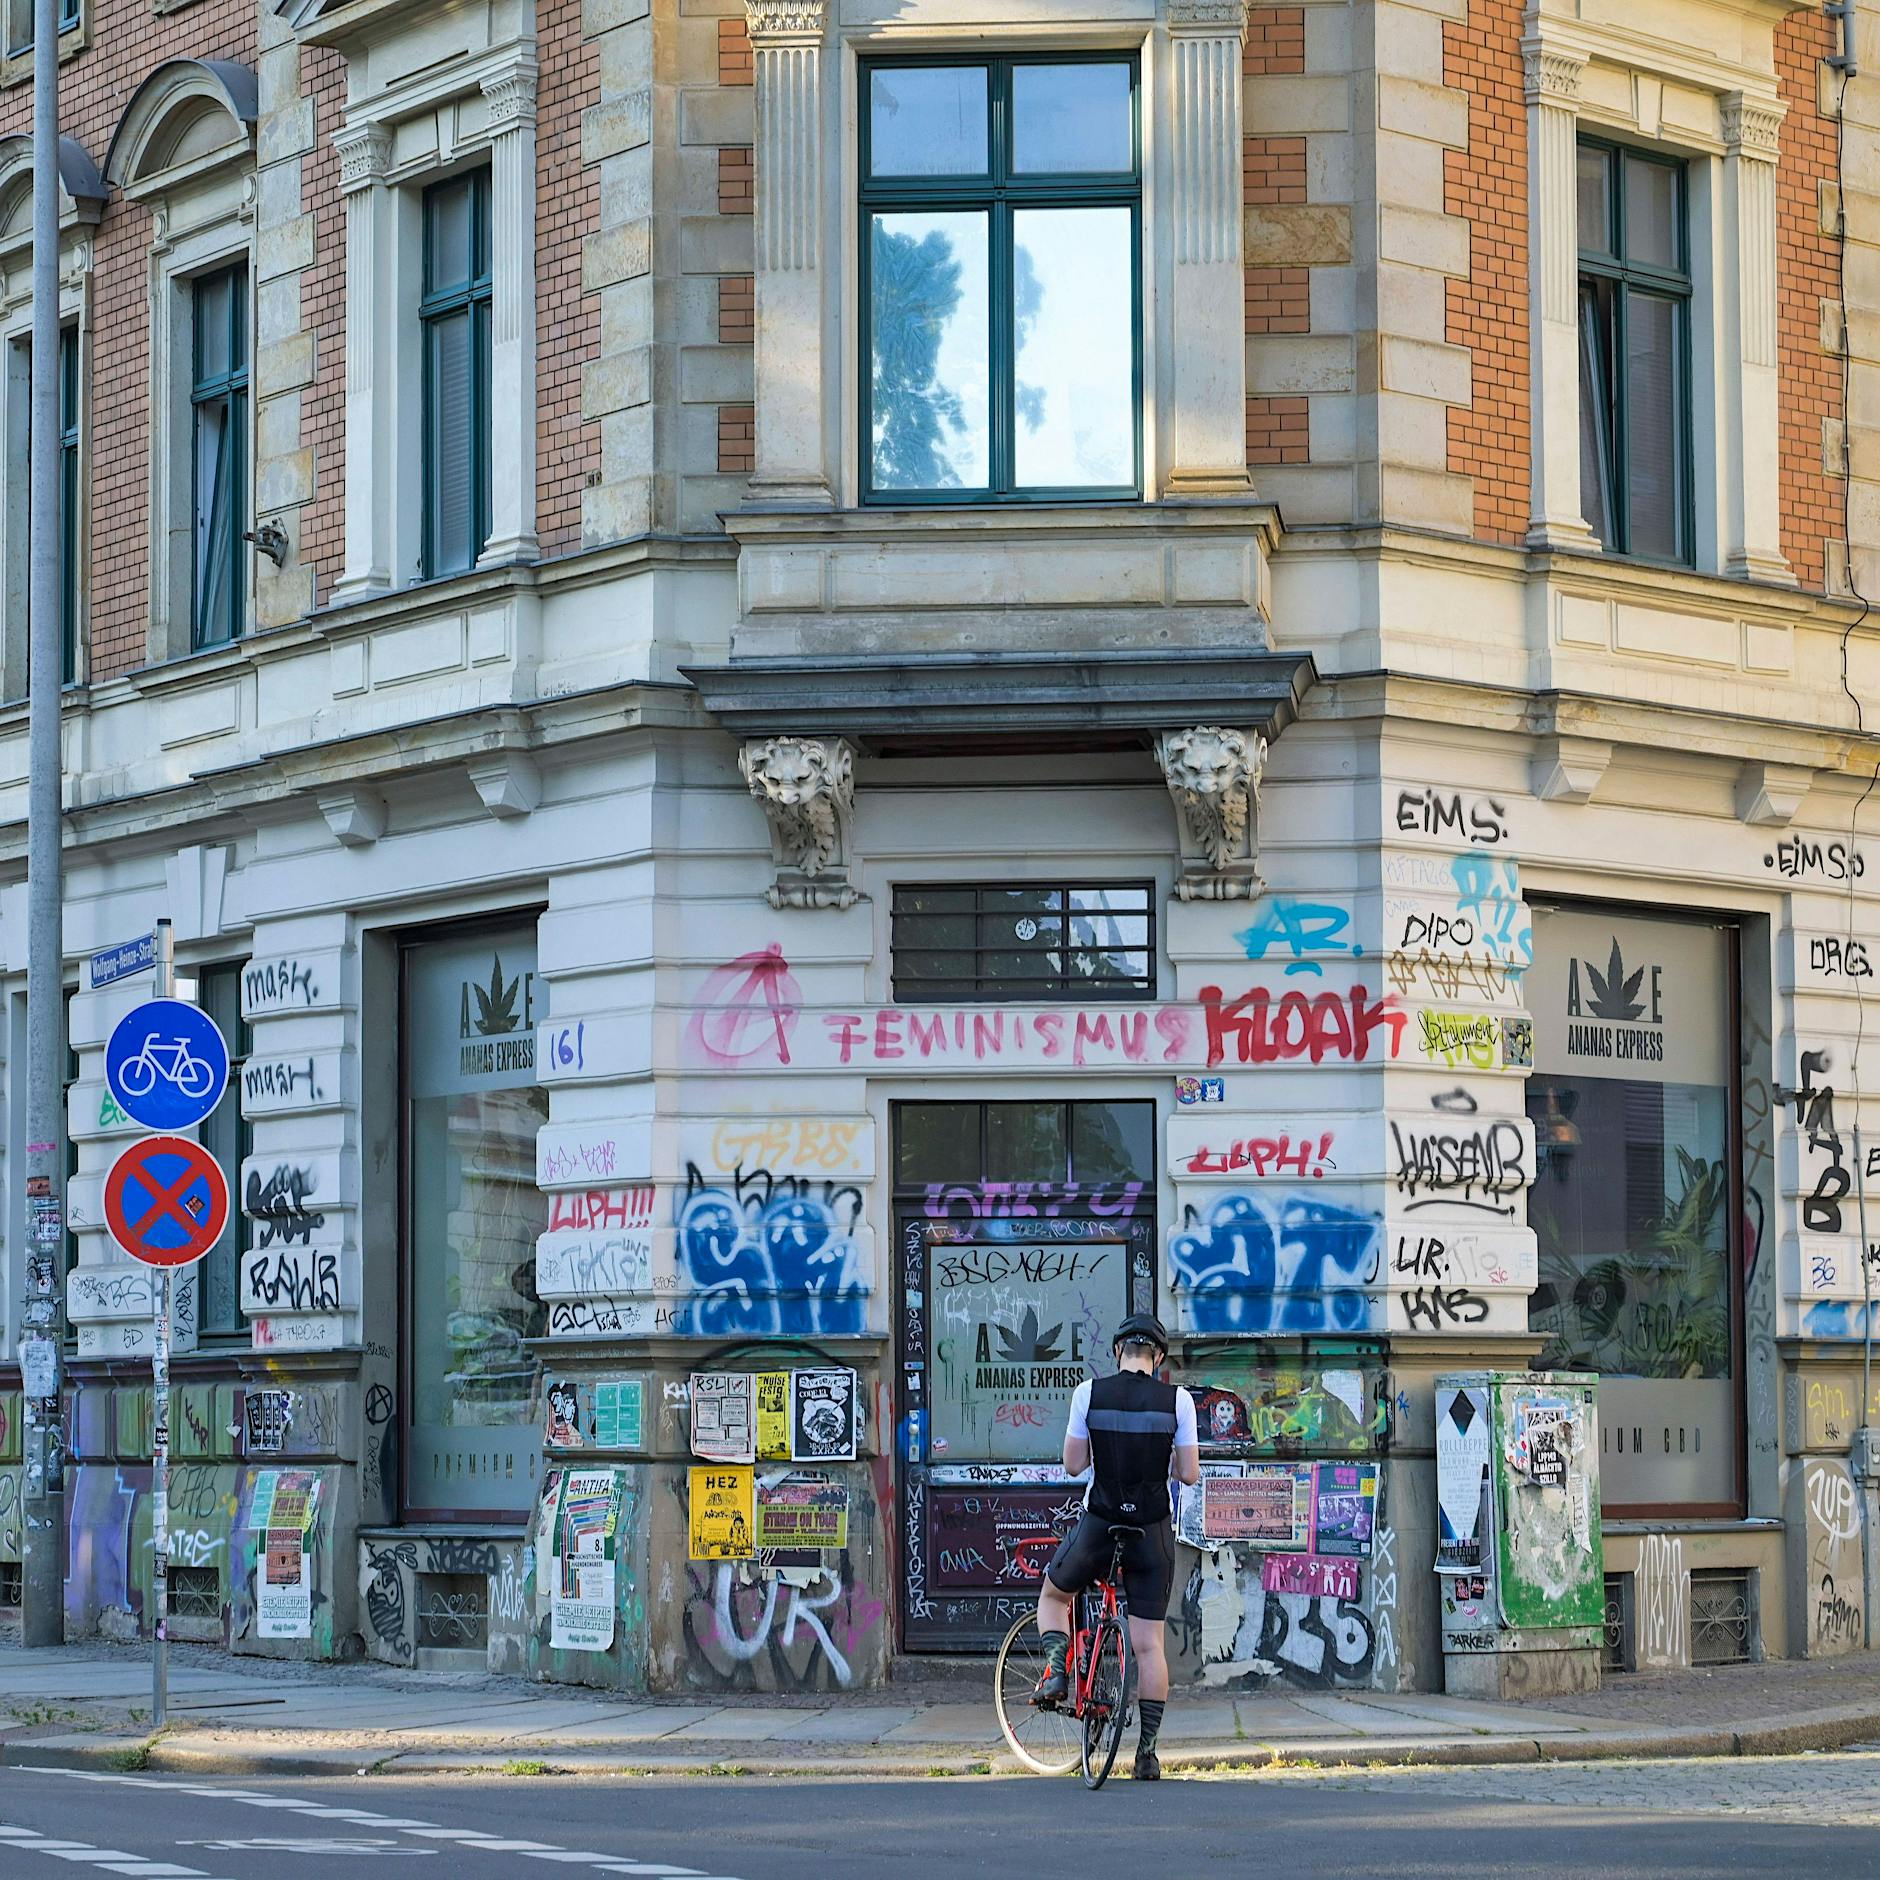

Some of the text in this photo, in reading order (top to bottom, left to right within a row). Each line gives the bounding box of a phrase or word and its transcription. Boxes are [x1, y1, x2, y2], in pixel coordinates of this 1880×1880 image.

[1401, 912, 1473, 948] DIPO
[822, 1006, 1190, 1067] FEMINISMUS
[1567, 1023, 1664, 1062] ANANAS EXPRESS
[460, 1038, 535, 1077] ANANAS EXPRESS
[975, 1367, 1084, 1389] ANANAS EXPRESS
[705, 1476, 739, 1490] HEZ
